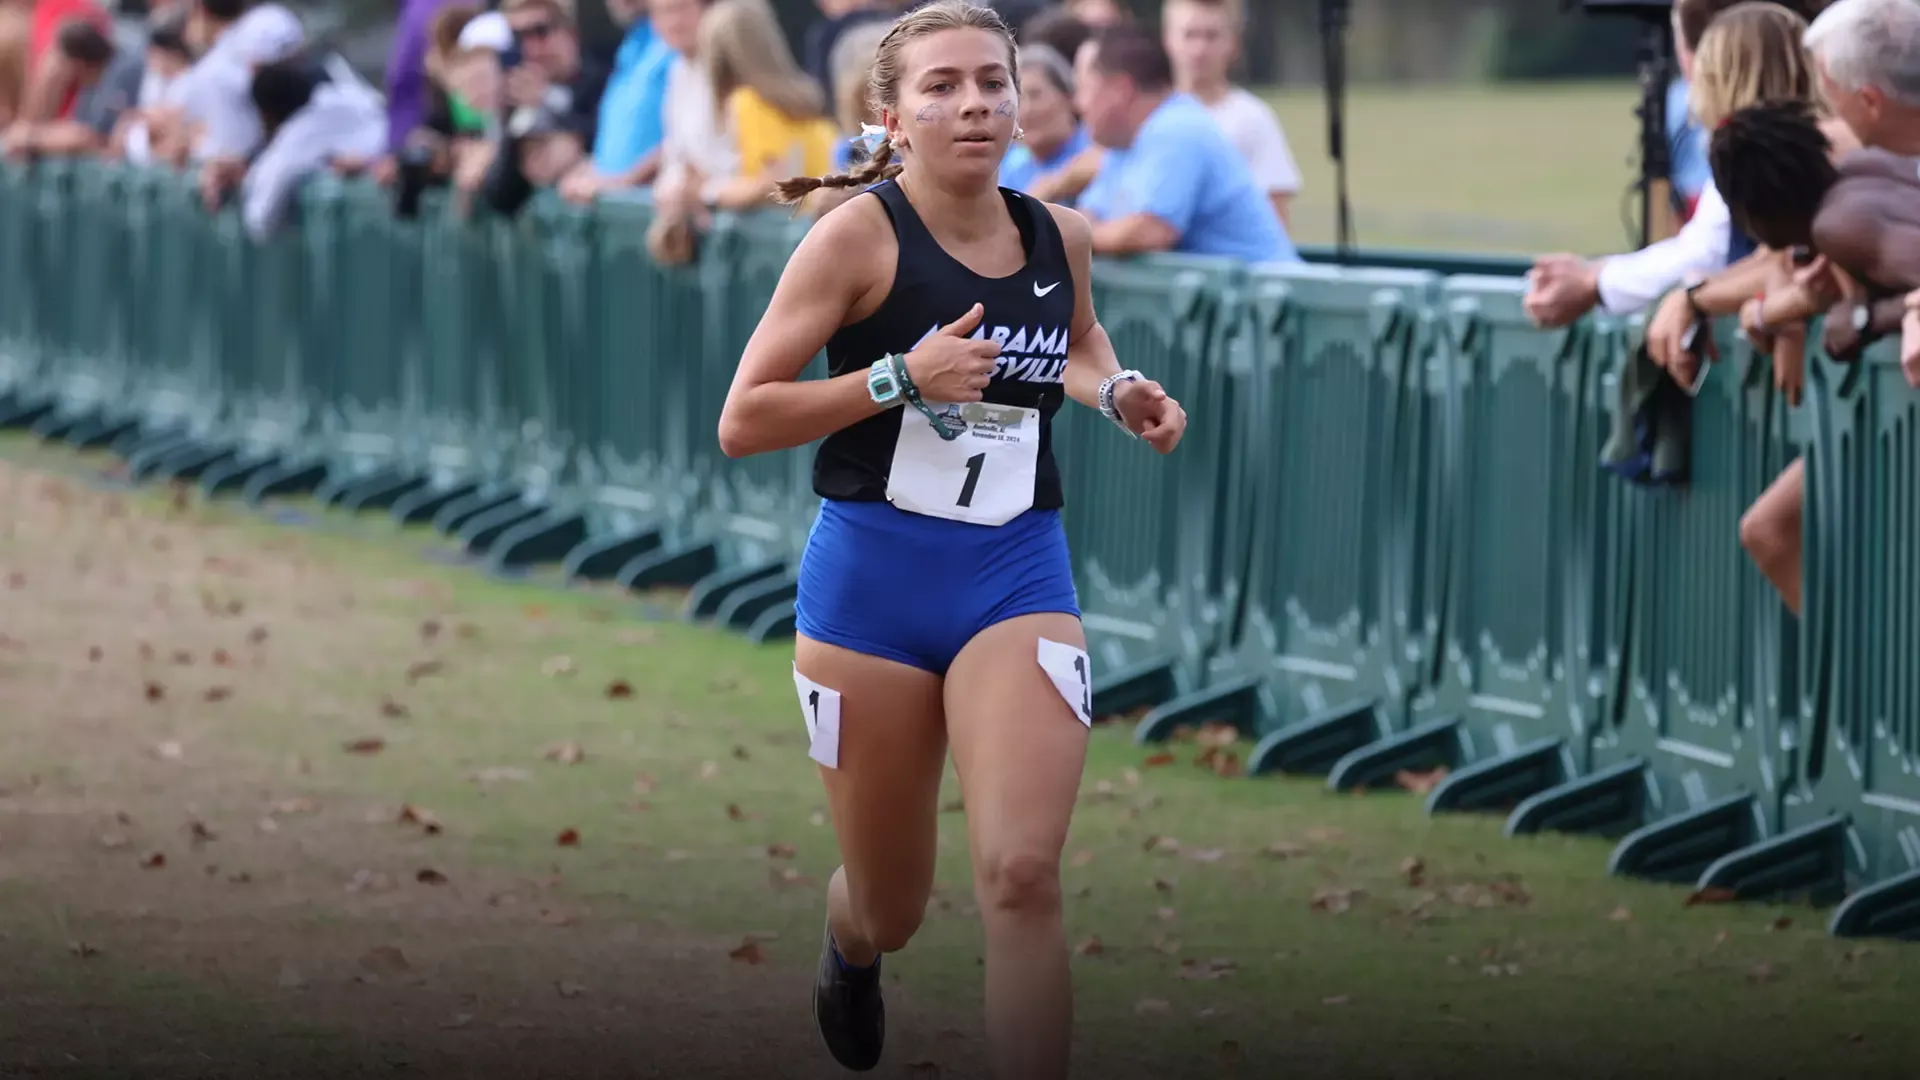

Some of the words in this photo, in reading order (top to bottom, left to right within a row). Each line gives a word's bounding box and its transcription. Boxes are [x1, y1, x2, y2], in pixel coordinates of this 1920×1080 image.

[910, 322, 1068, 355] ABAMA
[956, 453, 986, 508] 1
[809, 690, 820, 727] 1
[1074, 655, 1091, 718] 1
